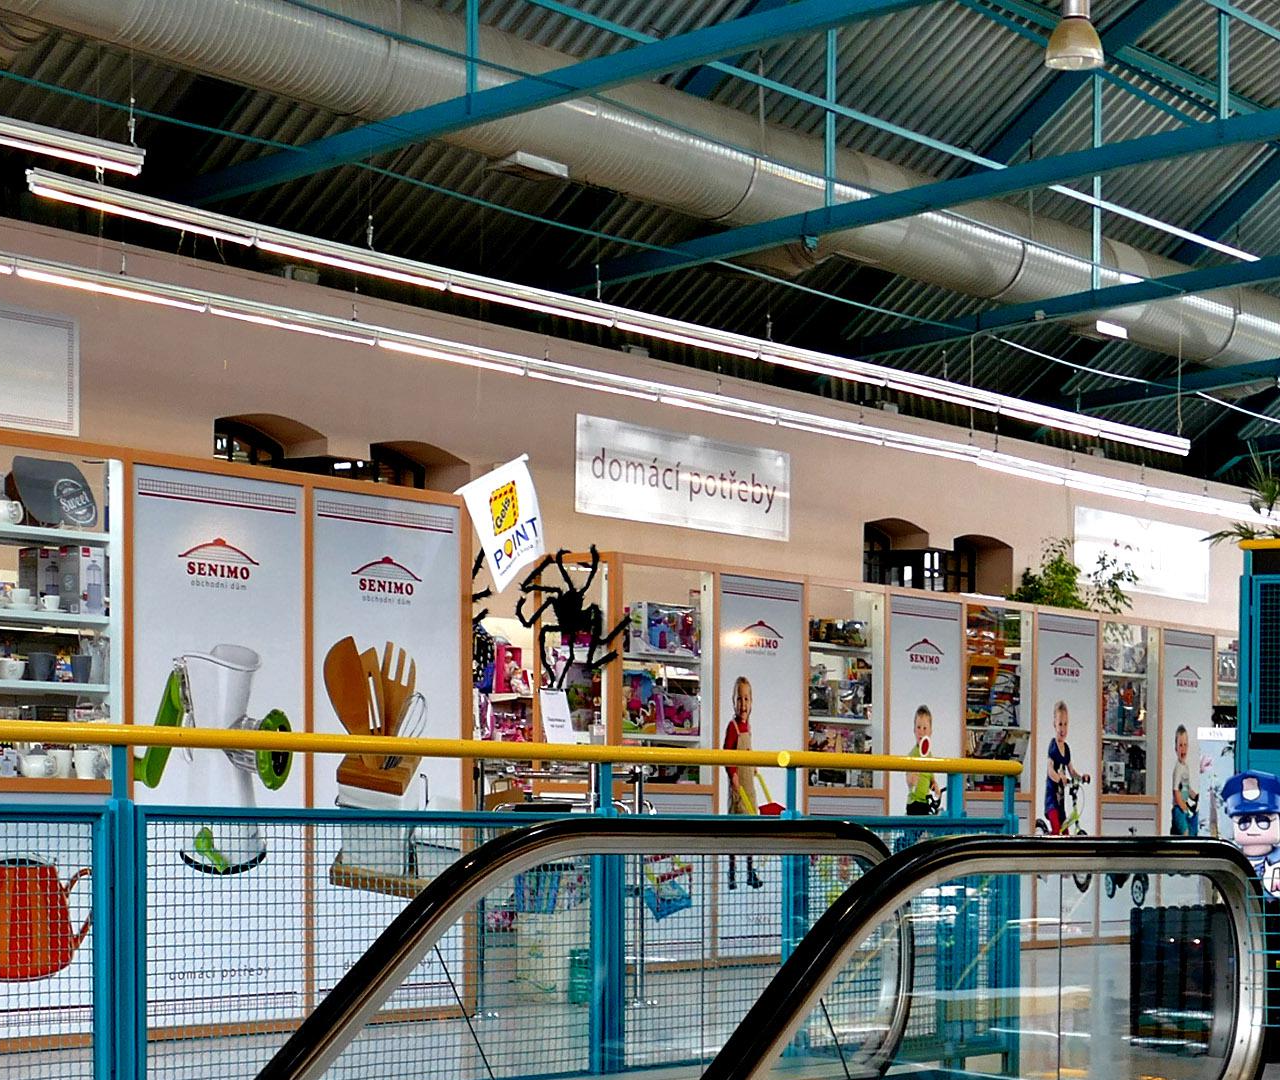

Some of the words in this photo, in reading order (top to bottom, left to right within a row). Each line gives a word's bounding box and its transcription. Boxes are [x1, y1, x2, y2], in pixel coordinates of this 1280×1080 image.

[591, 447, 681, 492] domácí
[689, 470, 777, 514] potřeby
[186, 561, 251, 581] SENIMO
[358, 577, 415, 596] SENIMO
[744, 636, 779, 650] ENIMO
[909, 652, 941, 666] SENIMO
[1053, 666, 1081, 678] SENIMO
[1176, 678, 1199, 689] SENIMO
